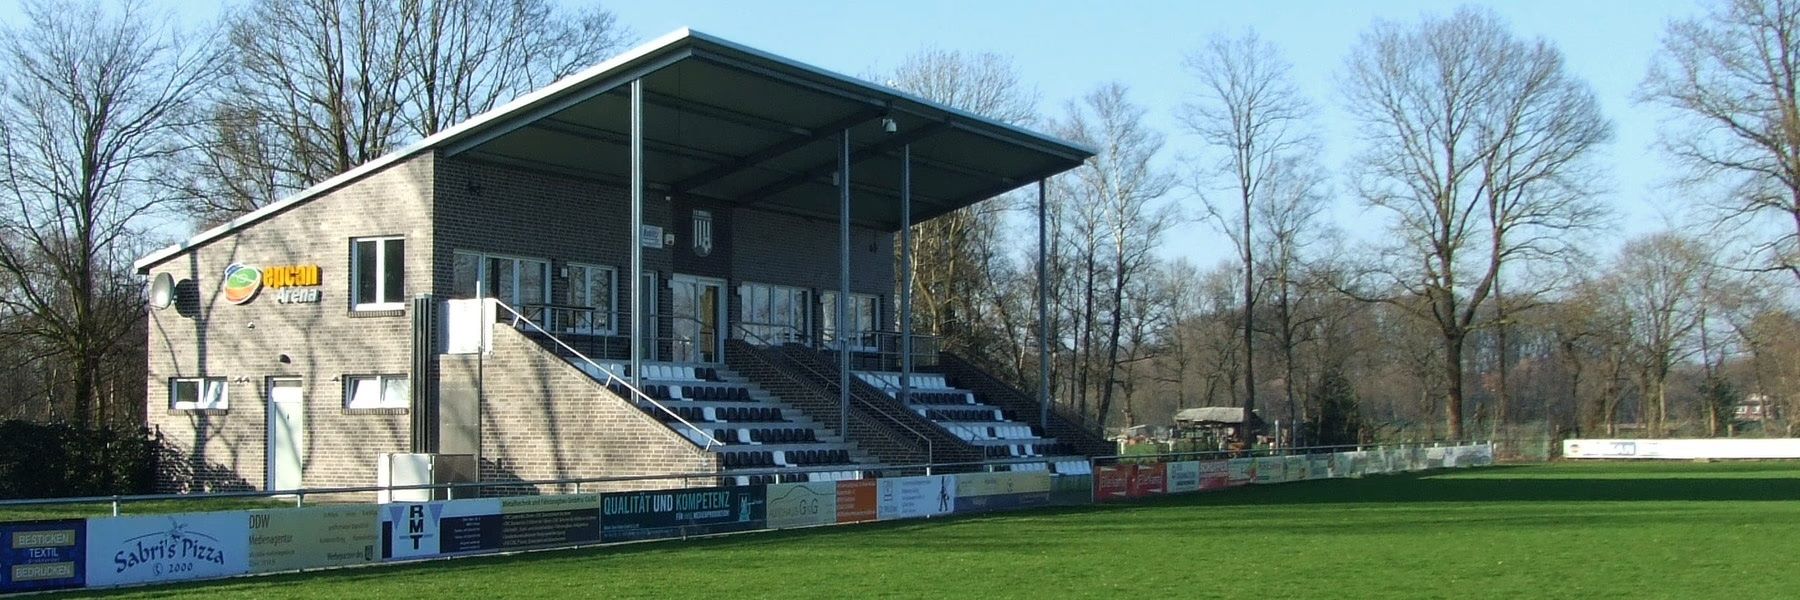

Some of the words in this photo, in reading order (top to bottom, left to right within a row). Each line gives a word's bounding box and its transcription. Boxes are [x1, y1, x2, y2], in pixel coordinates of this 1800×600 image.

[263, 264, 318, 288] epcan
[278, 287, 317, 303] Arena
[604, 492, 650, 515] QUALITÄT
[653, 494, 673, 512] UND
[675, 491, 730, 511] KOMPETENZ
[249, 514, 270, 529] DDW
[18, 533, 71, 546] BESTICKEN
[29, 547, 59, 558] TEXTIL
[114, 539, 176, 573] Sabri's
[182, 538, 225, 565] Pizza
[15, 565, 71, 578] BEDRUCKEN
[168, 562, 193, 574] 2000
